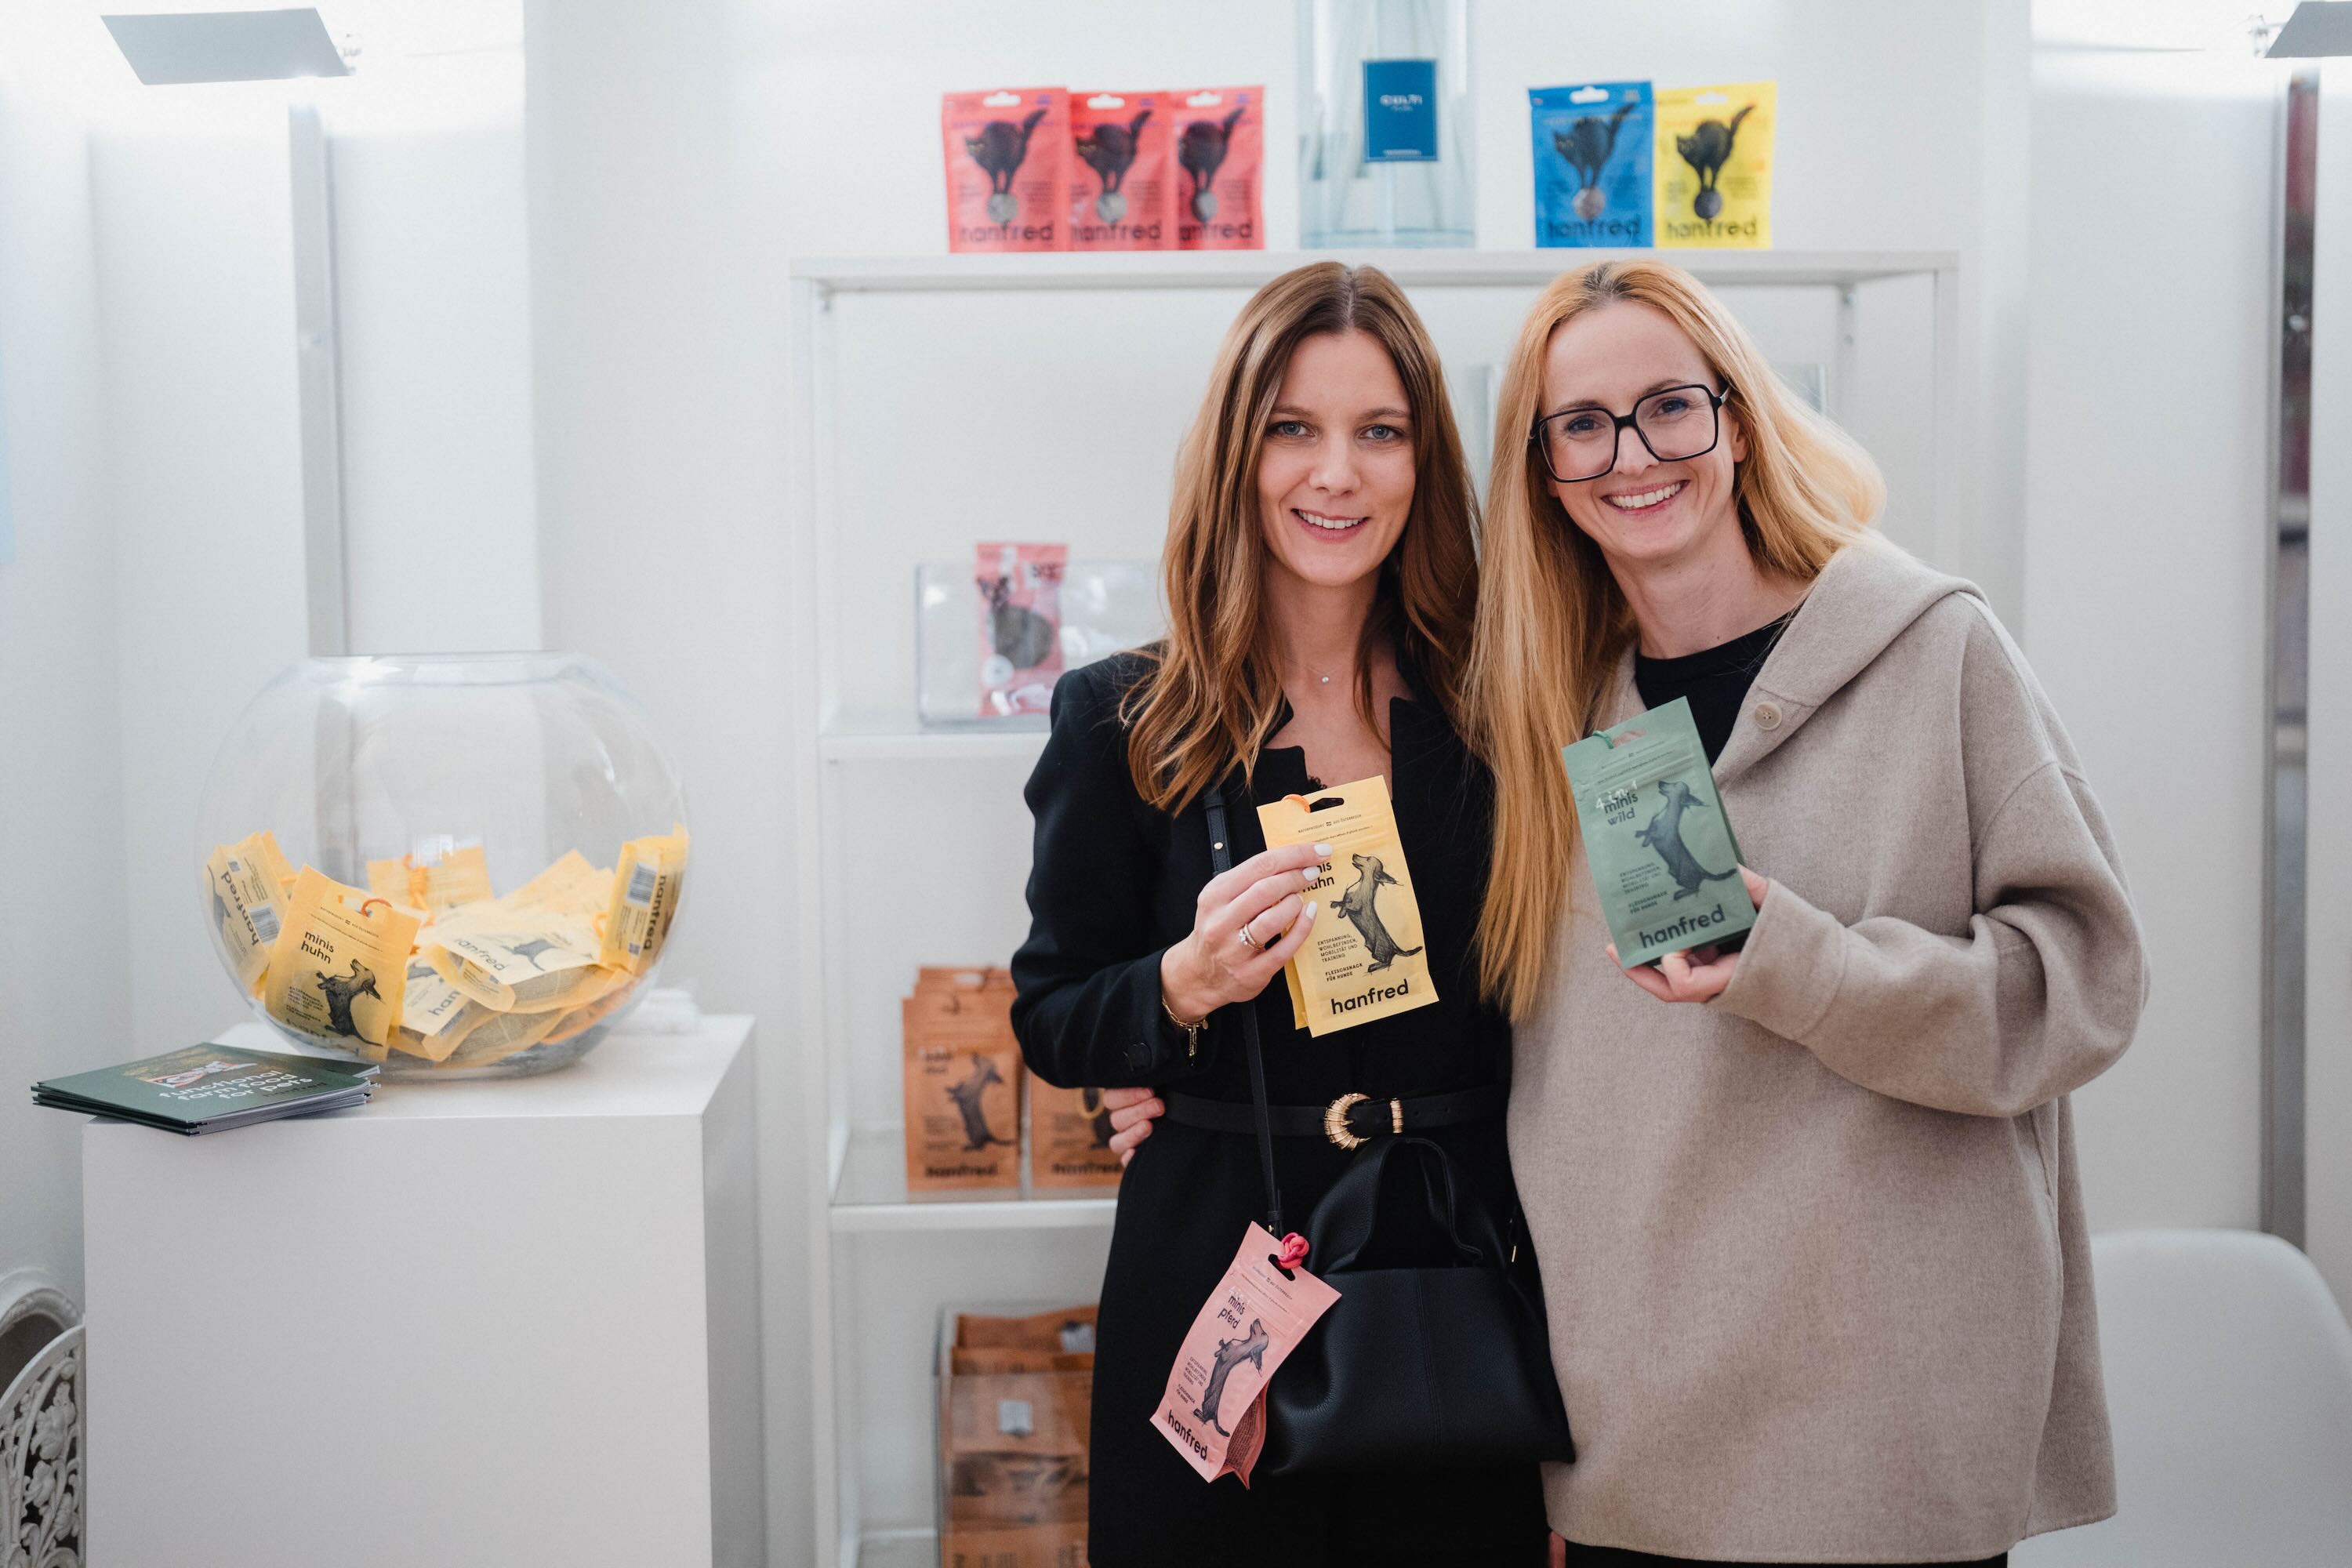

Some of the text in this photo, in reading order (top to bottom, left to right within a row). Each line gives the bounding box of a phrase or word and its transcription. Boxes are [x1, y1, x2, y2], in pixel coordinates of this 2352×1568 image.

[1604, 792, 1639, 815] minis
[1607, 808, 1636, 826] wild
[1302, 876, 1335, 892] uhn
[1639, 903, 1726, 949] hanfred
[301, 940, 332, 964] huhn
[304, 931, 335, 953] minis
[1330, 978, 1409, 1015] hanfred
[159, 1069, 284, 1098] functional
[177, 1073, 298, 1101] farm food
[219, 1077, 313, 1099] for pets
[1228, 1295, 1246, 1316] minis
[1217, 1308, 1241, 1330] pferd
[1167, 1409, 1208, 1461] hanfred
